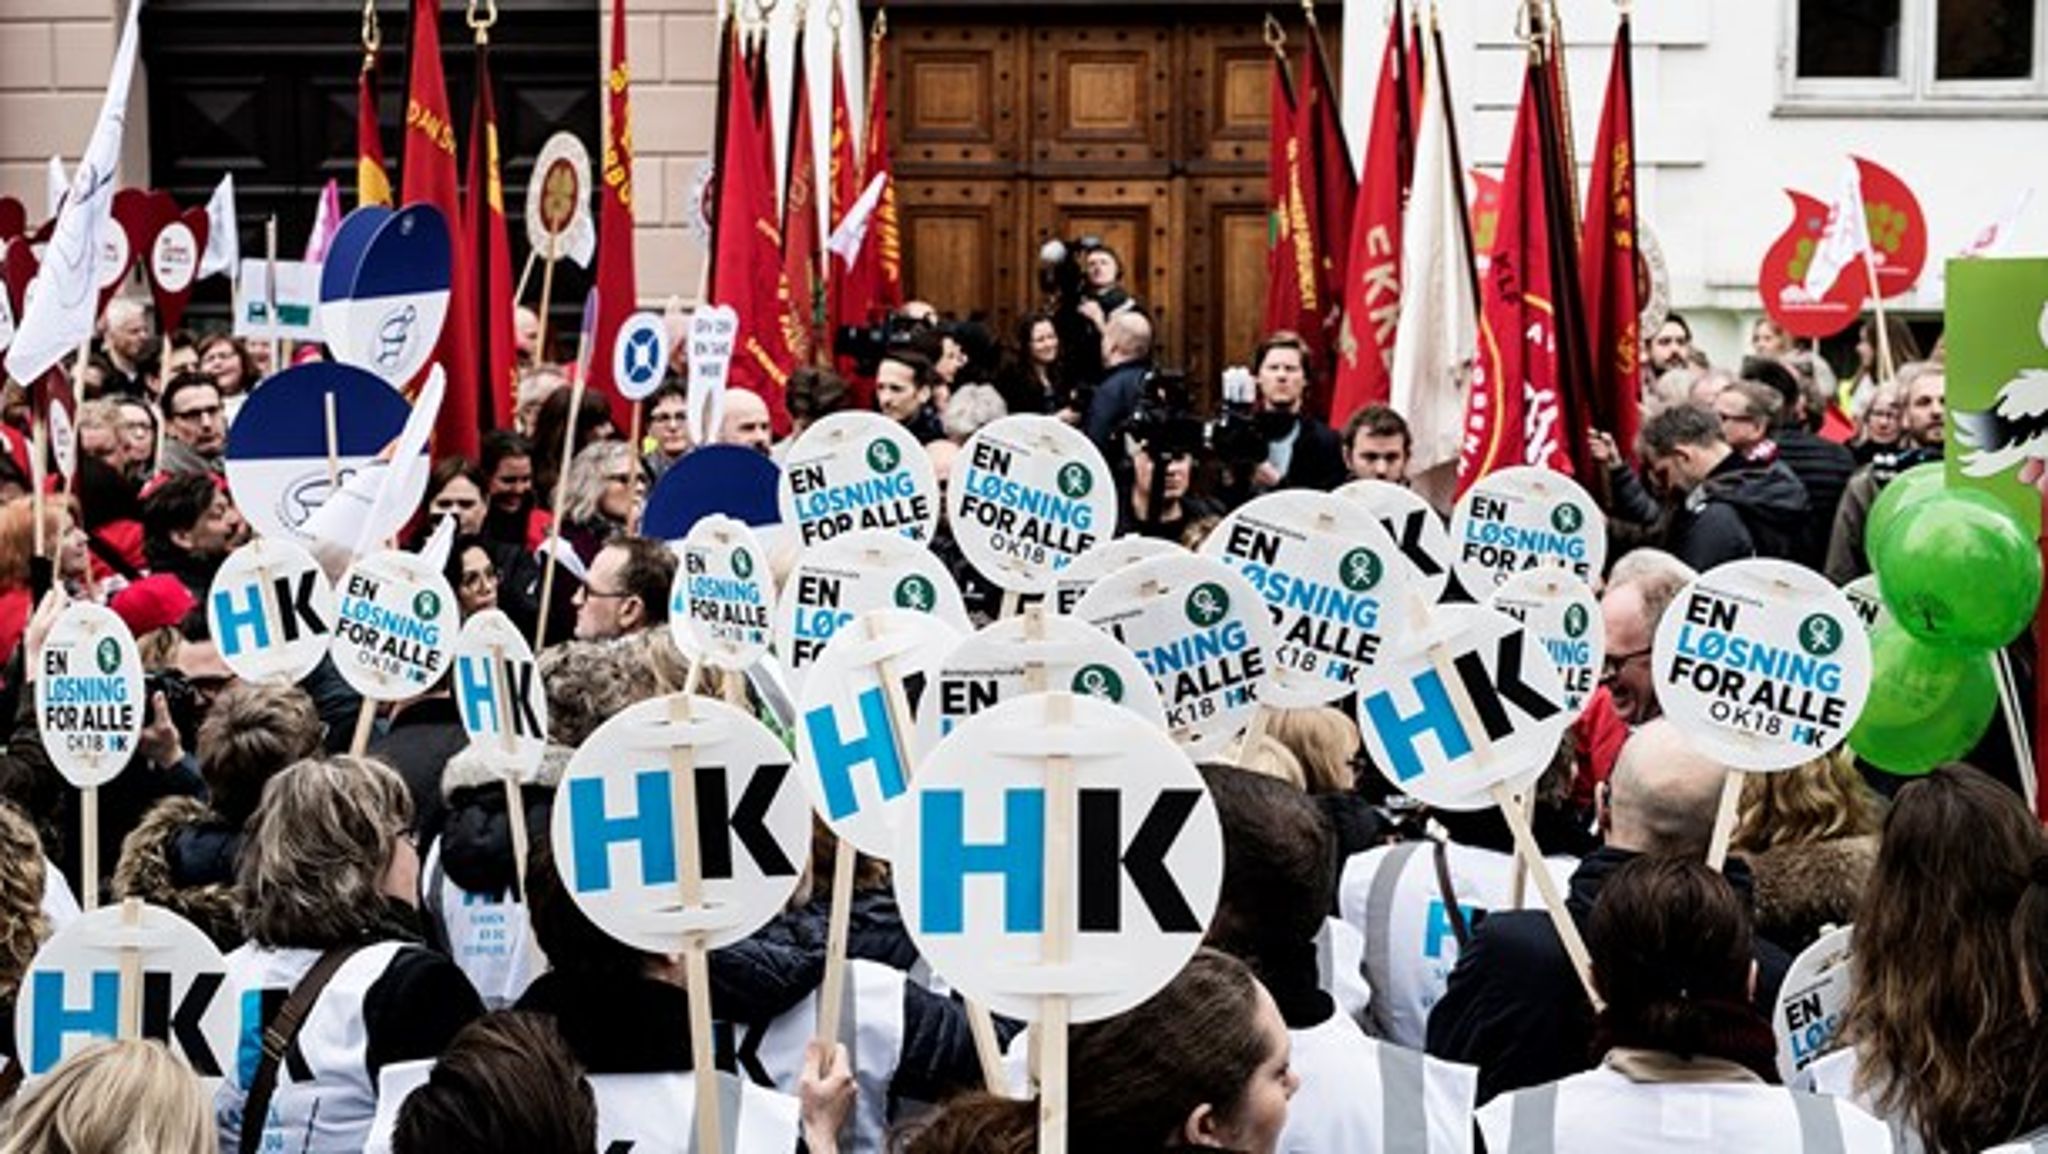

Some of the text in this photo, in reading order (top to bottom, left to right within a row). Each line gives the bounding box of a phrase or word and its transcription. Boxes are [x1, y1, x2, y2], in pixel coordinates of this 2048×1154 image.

[972, 443, 1012, 477] EN
[789, 466, 826, 495] EN
[794, 472, 915, 520] LØSNING
[966, 468, 1092, 530] LØSNING
[861, 495, 929, 529] ALLE
[960, 496, 1095, 555] FOR ALLE
[1470, 496, 1508, 522] EN
[990, 534, 1046, 565] OK18
[1226, 525, 1281, 566] EN
[1462, 543, 1517, 572] FOR
[1466, 520, 1585, 559] LØSNING
[686, 553, 707, 574] EN
[348, 574, 380, 601] EN
[687, 575, 760, 605] LØSNING
[799, 576, 841, 608] EN
[1058, 589, 1086, 614] E
[215, 569, 329, 656] HK
[341, 597, 441, 647] LØSNING
[690, 599, 719, 622] FOR
[723, 602, 768, 628] ALLE
[1685, 593, 1739, 632] EN
[335, 620, 441, 673] FOR ALLE
[1285, 616, 1381, 665] ALLE
[1678, 625, 1842, 693] LØSNING
[46, 651, 68, 676] EN
[358, 651, 428, 684] OK18 HK
[1174, 647, 1265, 704] ALLE
[1325, 660, 1360, 686] HK
[46, 677, 126, 704] LØSNING
[460, 656, 544, 740] HK
[942, 681, 999, 715] EN
[1166, 682, 1258, 729] K18 HK
[1363, 628, 1562, 782] HK
[1668, 655, 1847, 729] FOR ALLE
[46, 705, 134, 731] FOR ALLE
[1709, 701, 1827, 748] OK18 HK
[67, 733, 129, 752] OK18 HK
[569, 764, 799, 893] HK
[920, 788, 1204, 933] HK
[33, 971, 226, 1077] HK
[1785, 992, 1823, 1030] EN
